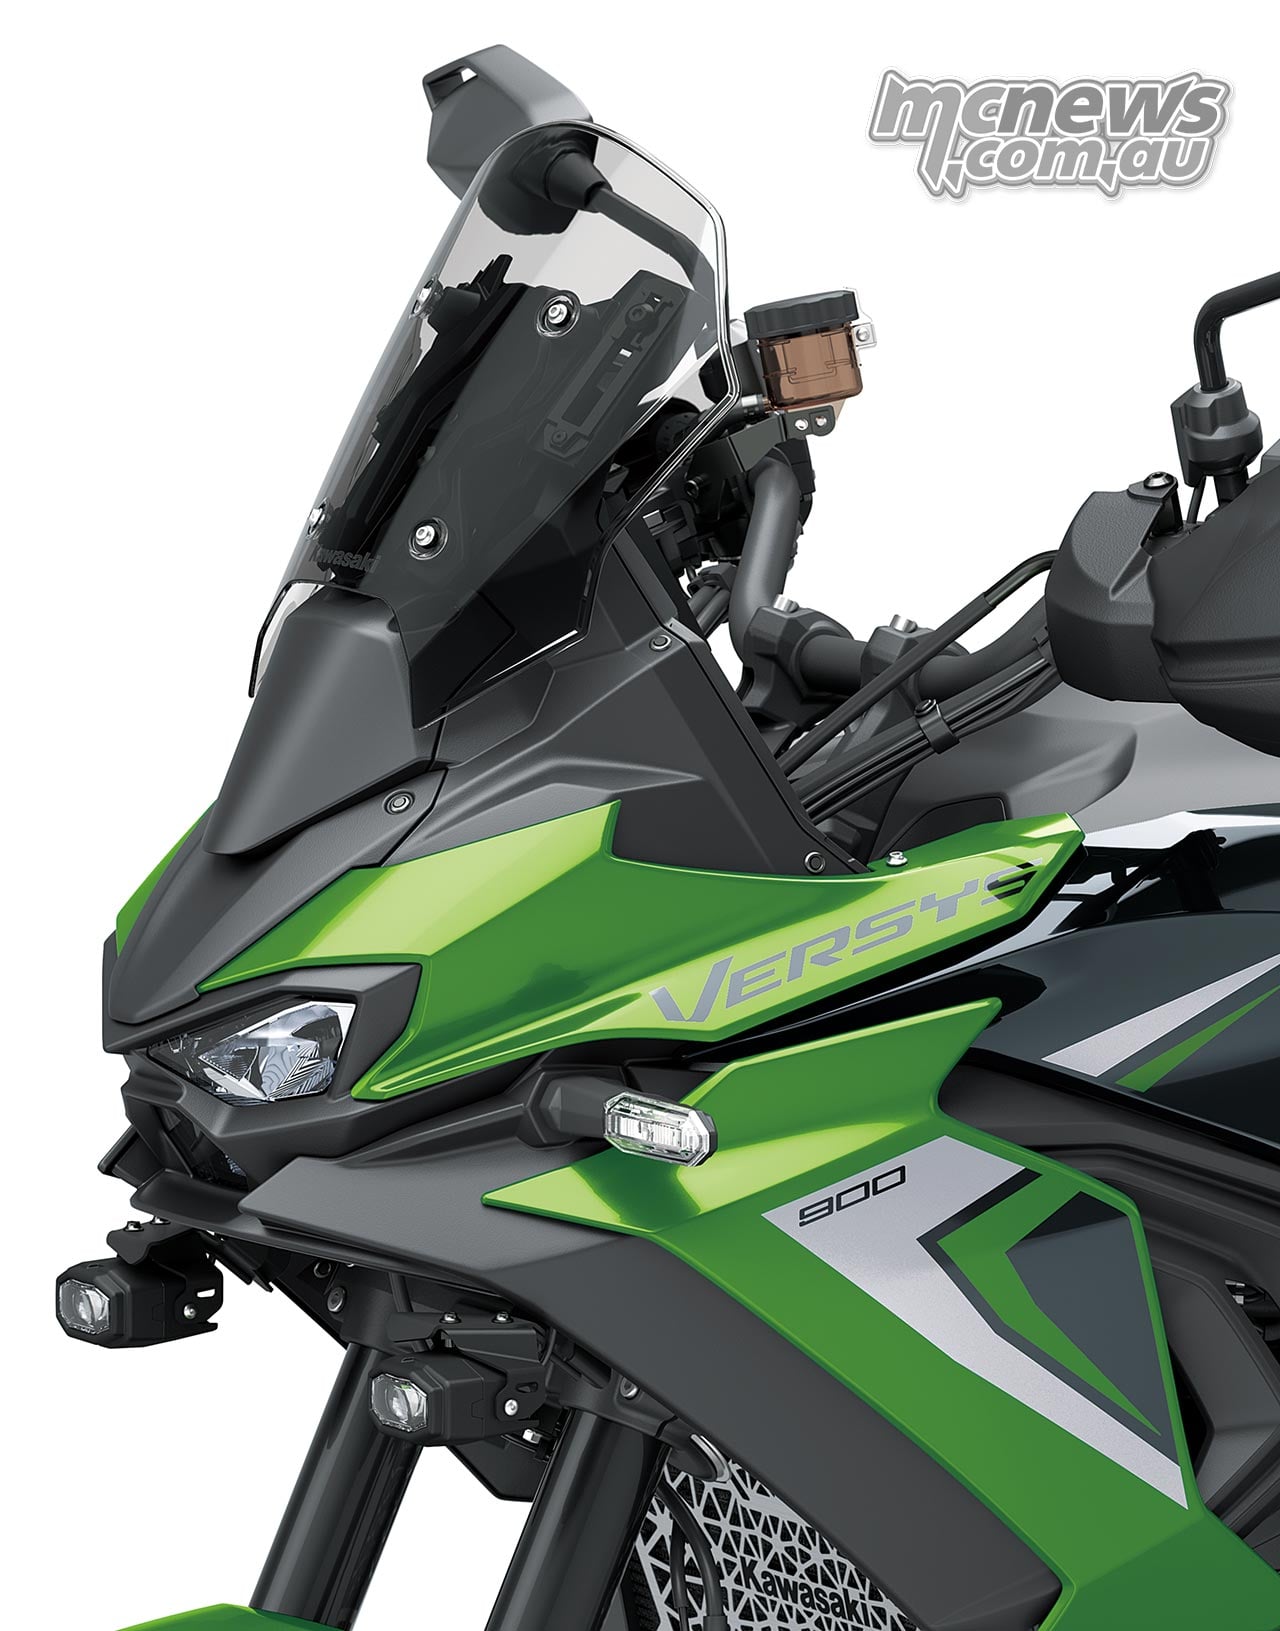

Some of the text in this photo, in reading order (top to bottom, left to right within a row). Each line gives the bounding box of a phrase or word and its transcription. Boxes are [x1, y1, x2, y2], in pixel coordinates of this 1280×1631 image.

[649, 858, 1041, 1022] VERSYS
[799, 1165, 906, 1228] 900
[740, 1555, 871, 1627] Kawasaki
